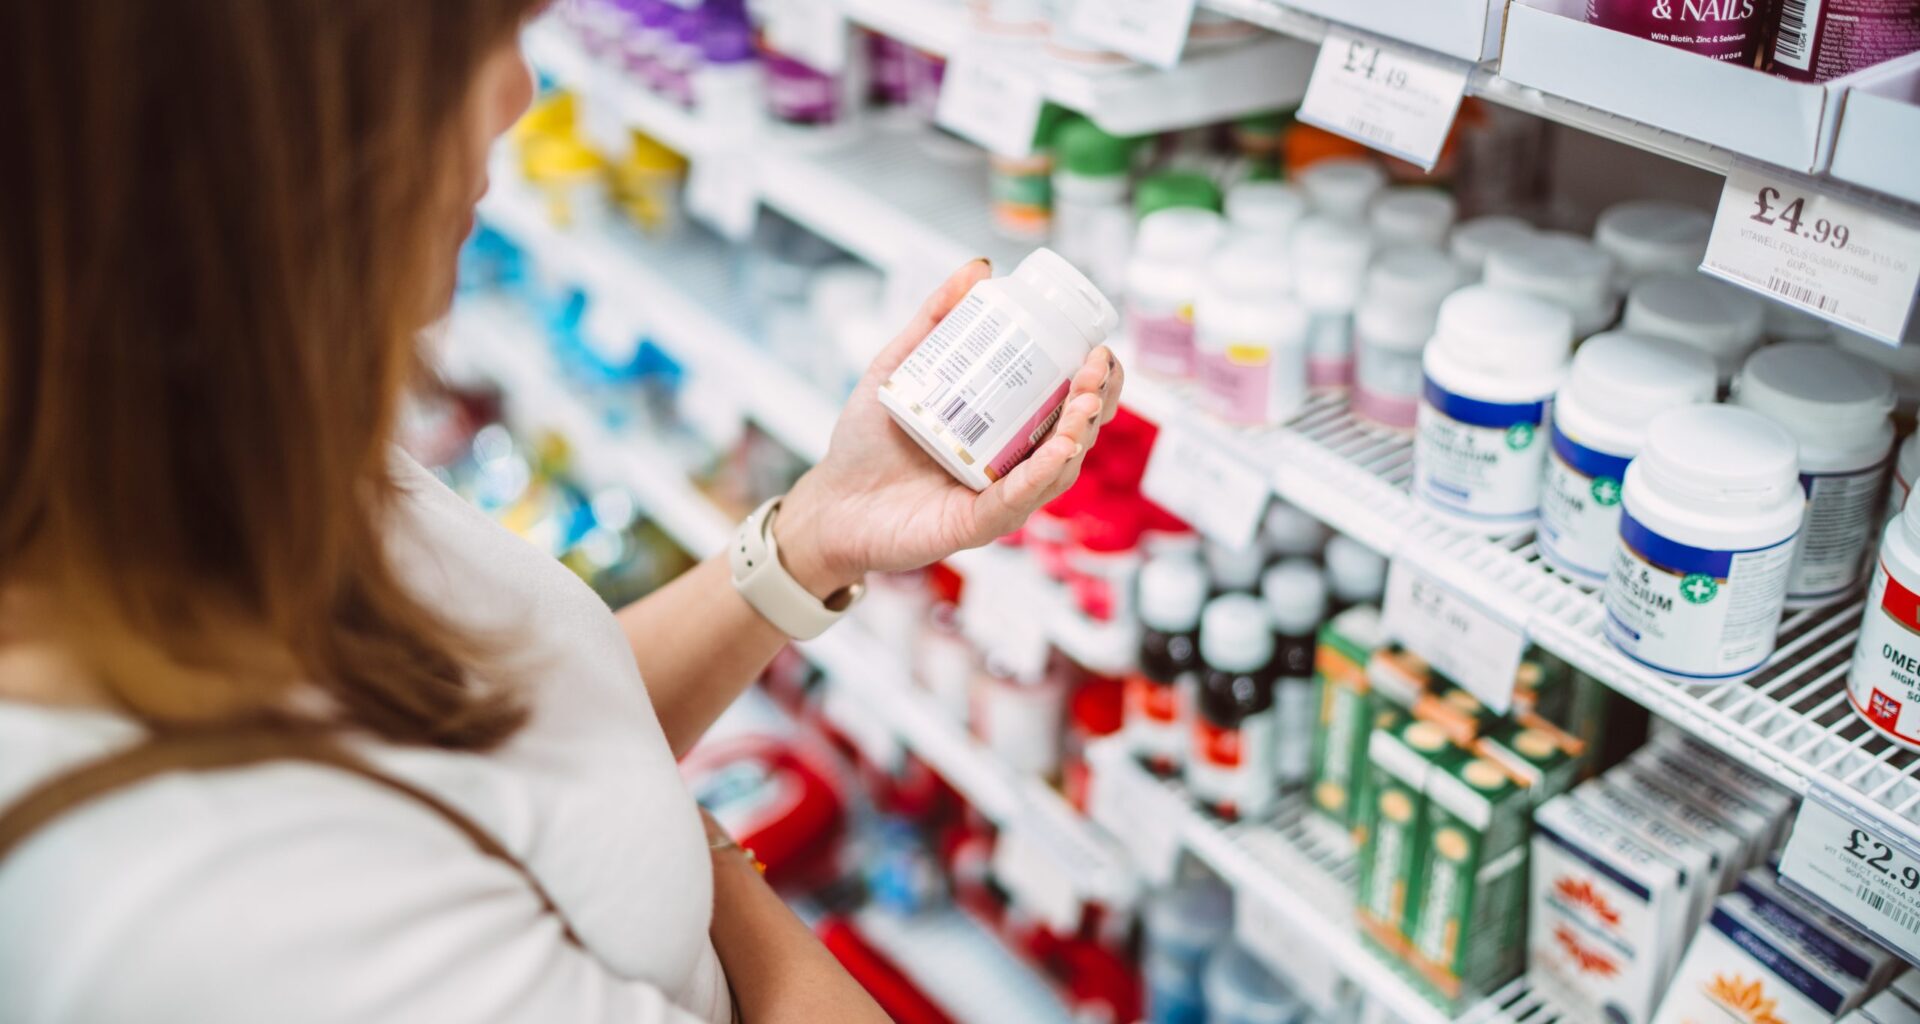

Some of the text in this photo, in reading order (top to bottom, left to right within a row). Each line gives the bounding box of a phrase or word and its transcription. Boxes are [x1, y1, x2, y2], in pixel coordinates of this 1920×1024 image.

[1651, 0, 1754, 22] & NAILS
[1651, 32, 1669, 42] With
[1670, 34, 1694, 44] Biotin,
[1695, 35, 1711, 43] Zinc
[1719, 33, 1746, 43] Selenium
[1342, 39, 1409, 89] £4.49
[1750, 187, 1849, 250] £4.99
[1740, 227, 1777, 250] VITAWELL
[1778, 241, 1808, 259] FOCUS
[1891, 669, 1915, 688] HIGH
[1838, 853, 1872, 876] DIRECT
[1873, 873, 1906, 899] OMEGA
[1843, 829, 1920, 895] £2.9
